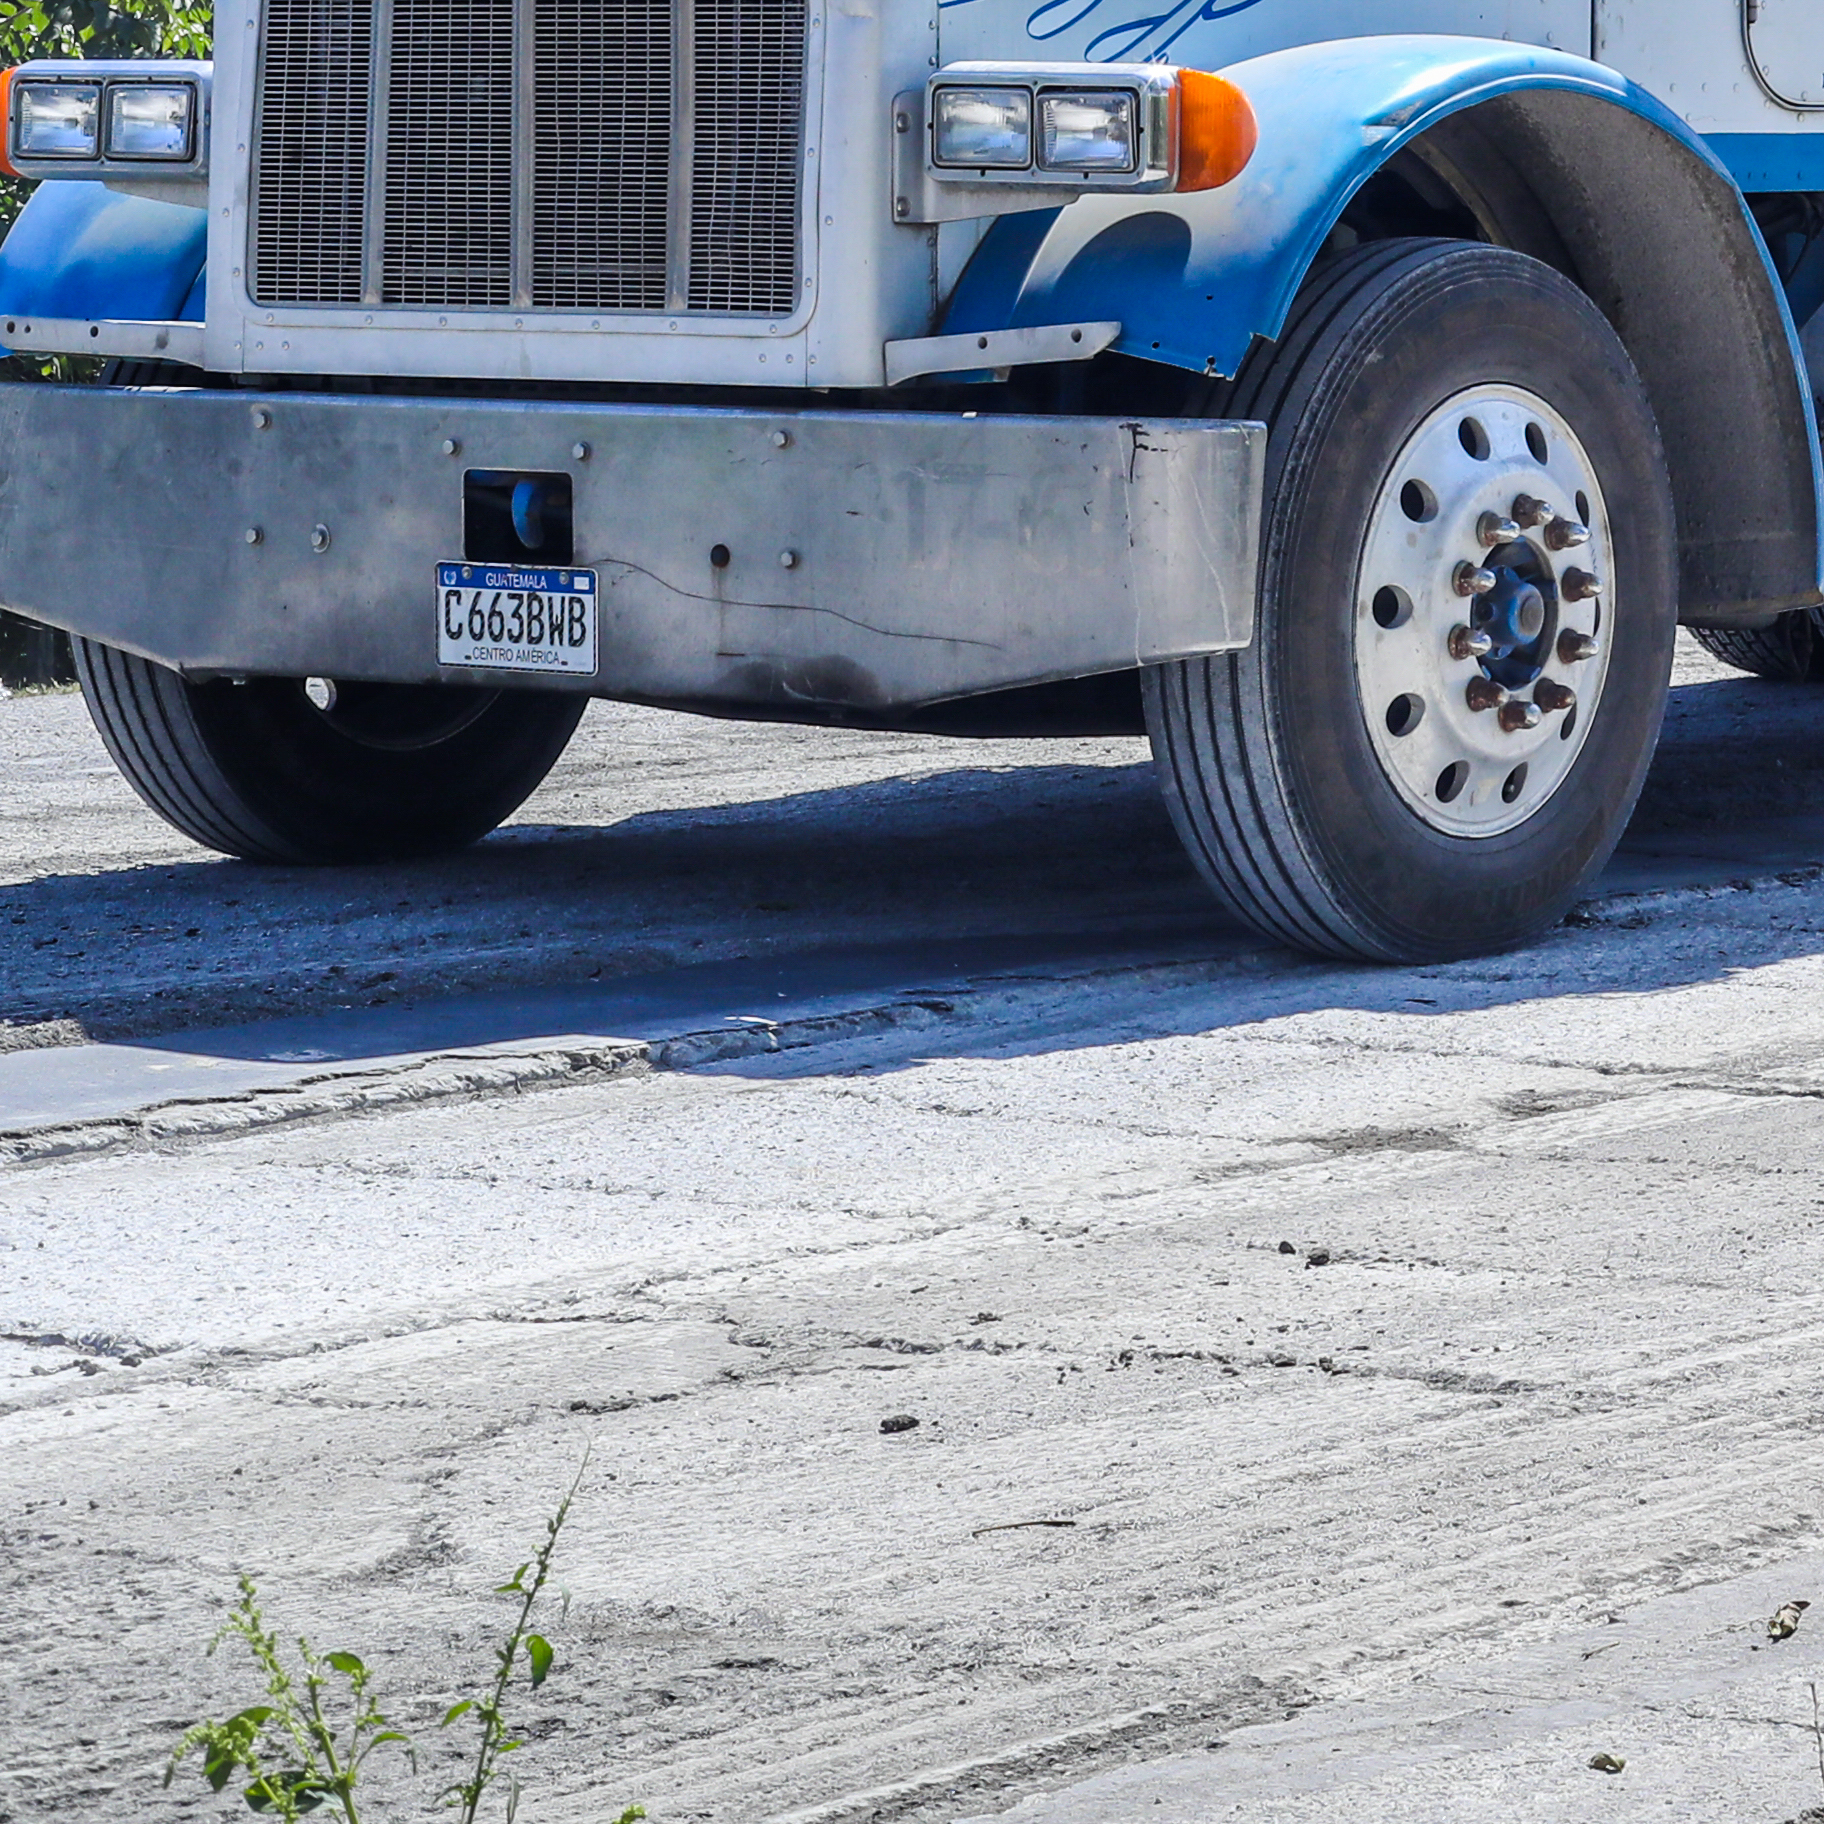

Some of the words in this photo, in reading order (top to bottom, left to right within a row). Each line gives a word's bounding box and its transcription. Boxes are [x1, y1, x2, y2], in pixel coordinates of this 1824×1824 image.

[485, 572, 547, 589] GUATEMALA
[445, 589, 587, 647] C663BWB
[473, 646, 514, 662] CENTRO
[516, 647, 560, 664] AMÉRICA
